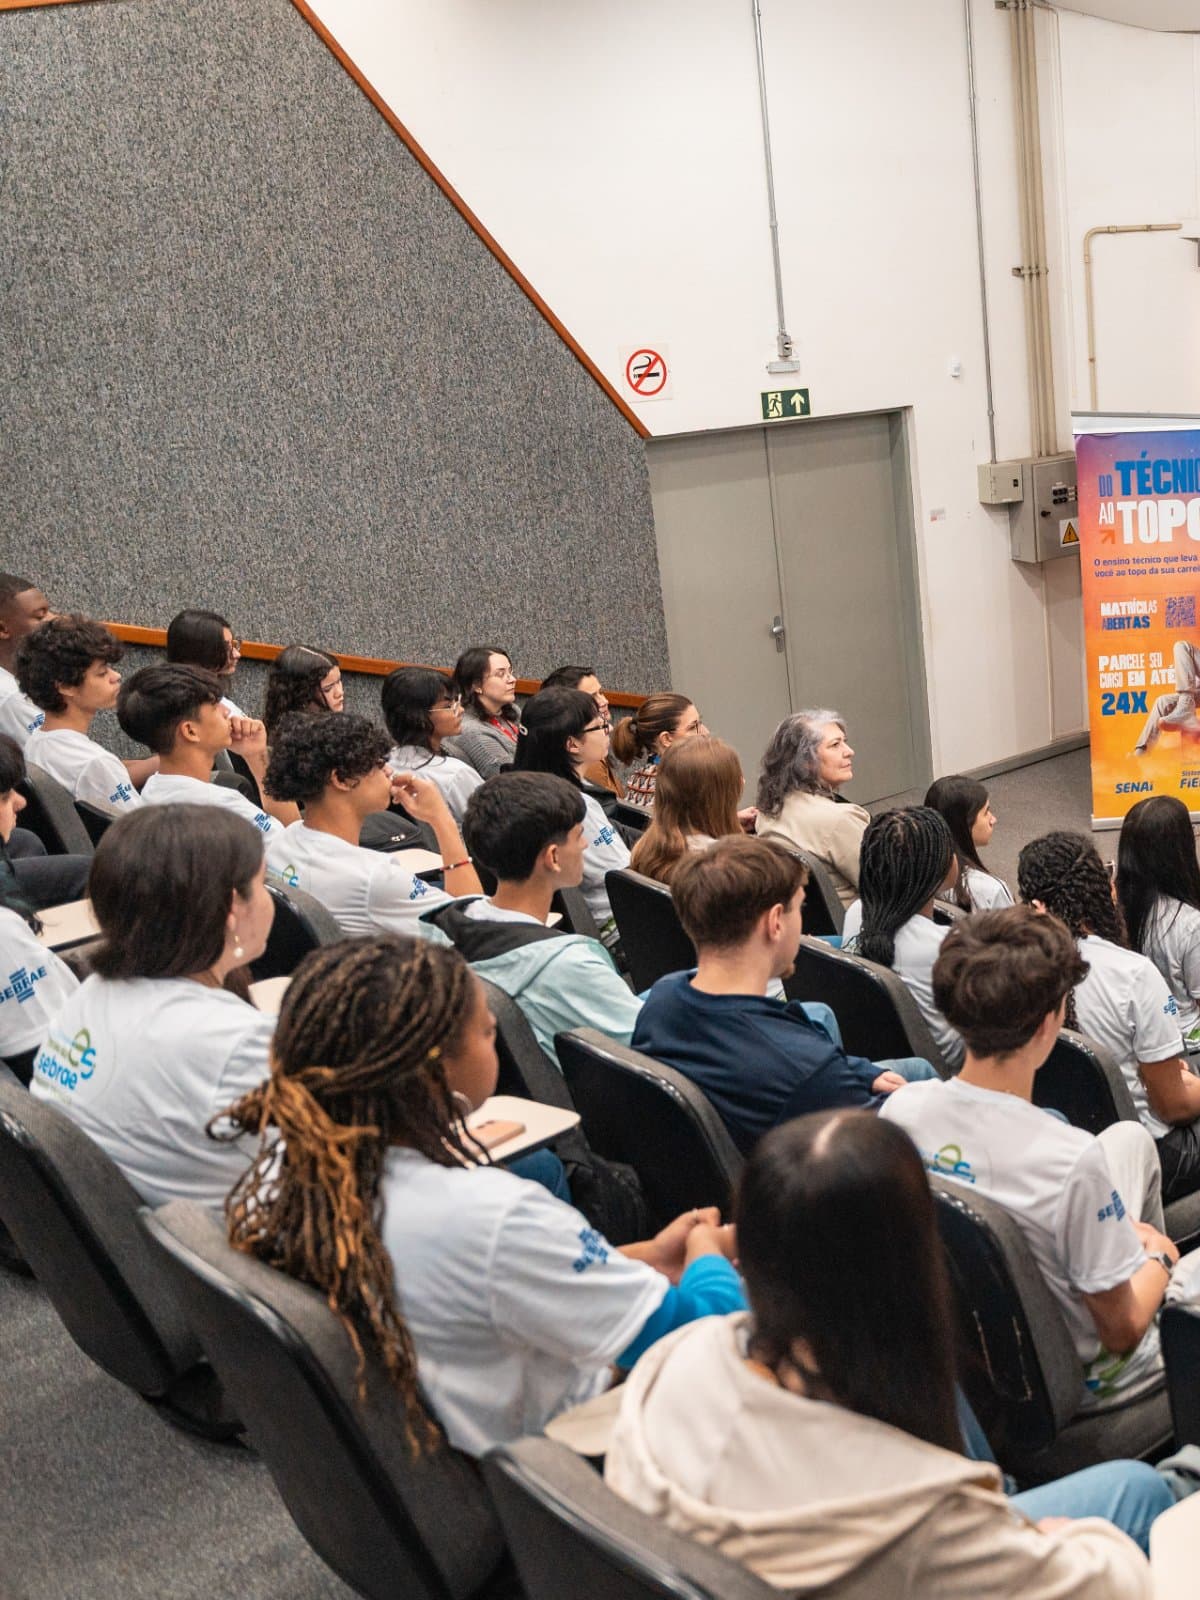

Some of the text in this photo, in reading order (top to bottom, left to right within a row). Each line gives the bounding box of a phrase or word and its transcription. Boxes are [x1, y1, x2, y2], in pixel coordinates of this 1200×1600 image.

[1098, 502, 1115, 525] AO
[1094, 558, 1100, 567] O
[1103, 556, 1130, 566] ensino
[1163, 555, 1179, 565] que
[1181, 553, 1198, 562] leva
[1128, 568, 1147, 577] topo
[1149, 567, 1159, 575] da
[1161, 567, 1175, 575] sua
[1102, 615, 1151, 631] ABERTAS
[1098, 652, 1163, 672] PARCELE SEU
[1099, 664, 1176, 689] CURSO EM ATÉ
[1101, 690, 1149, 716] 24X
[38, 1052, 78, 1091] sebrae
